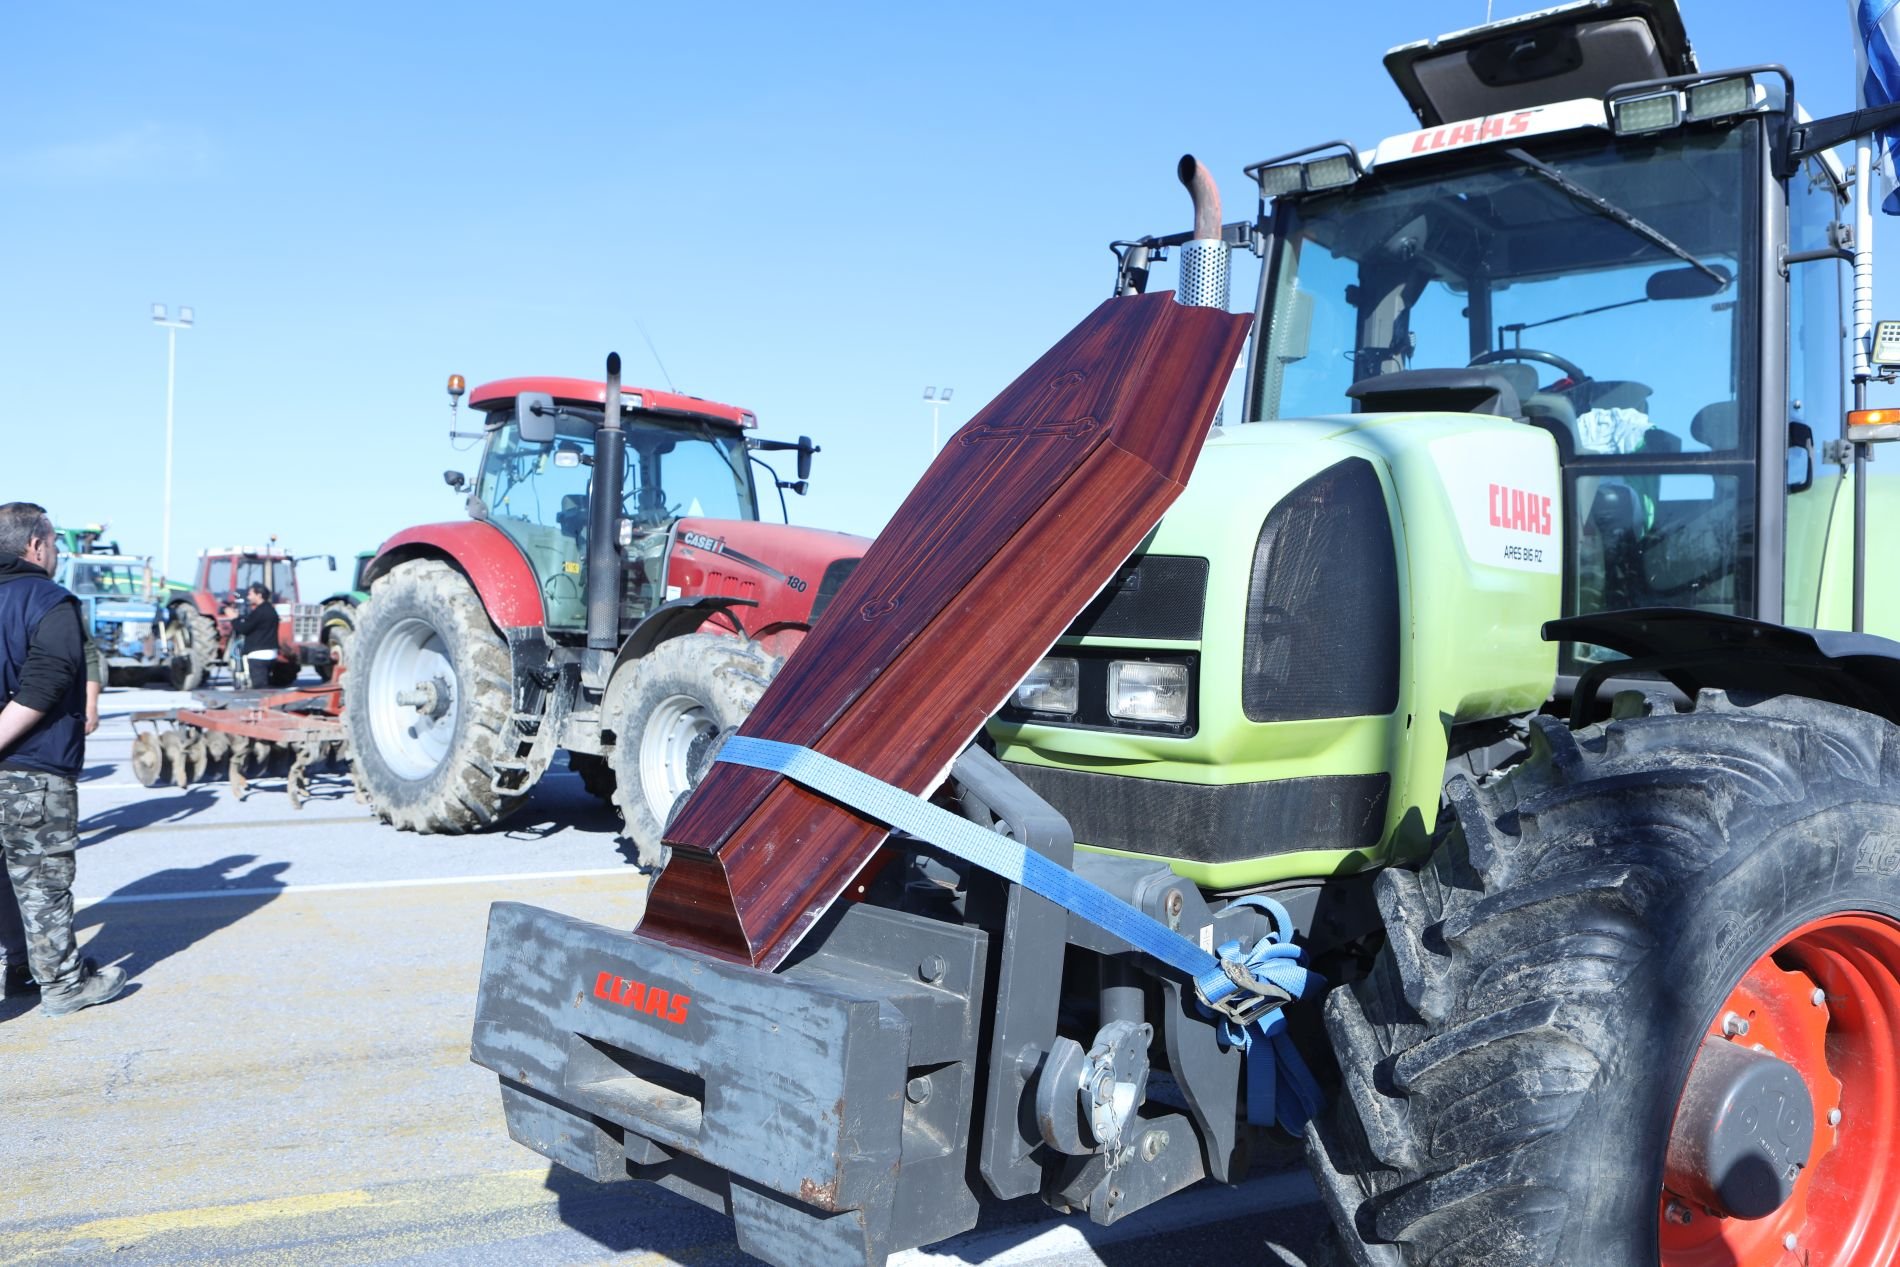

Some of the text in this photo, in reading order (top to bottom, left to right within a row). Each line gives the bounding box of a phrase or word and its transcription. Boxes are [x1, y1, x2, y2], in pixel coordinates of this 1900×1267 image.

[1411, 111, 1533, 153] CLAAS
[1488, 483, 1551, 536] CLAAS
[684, 531, 714, 551] CASE
[1503, 545, 1522, 561] ARES
[786, 575, 808, 593] 180
[593, 971, 691, 1025] CLAAS
